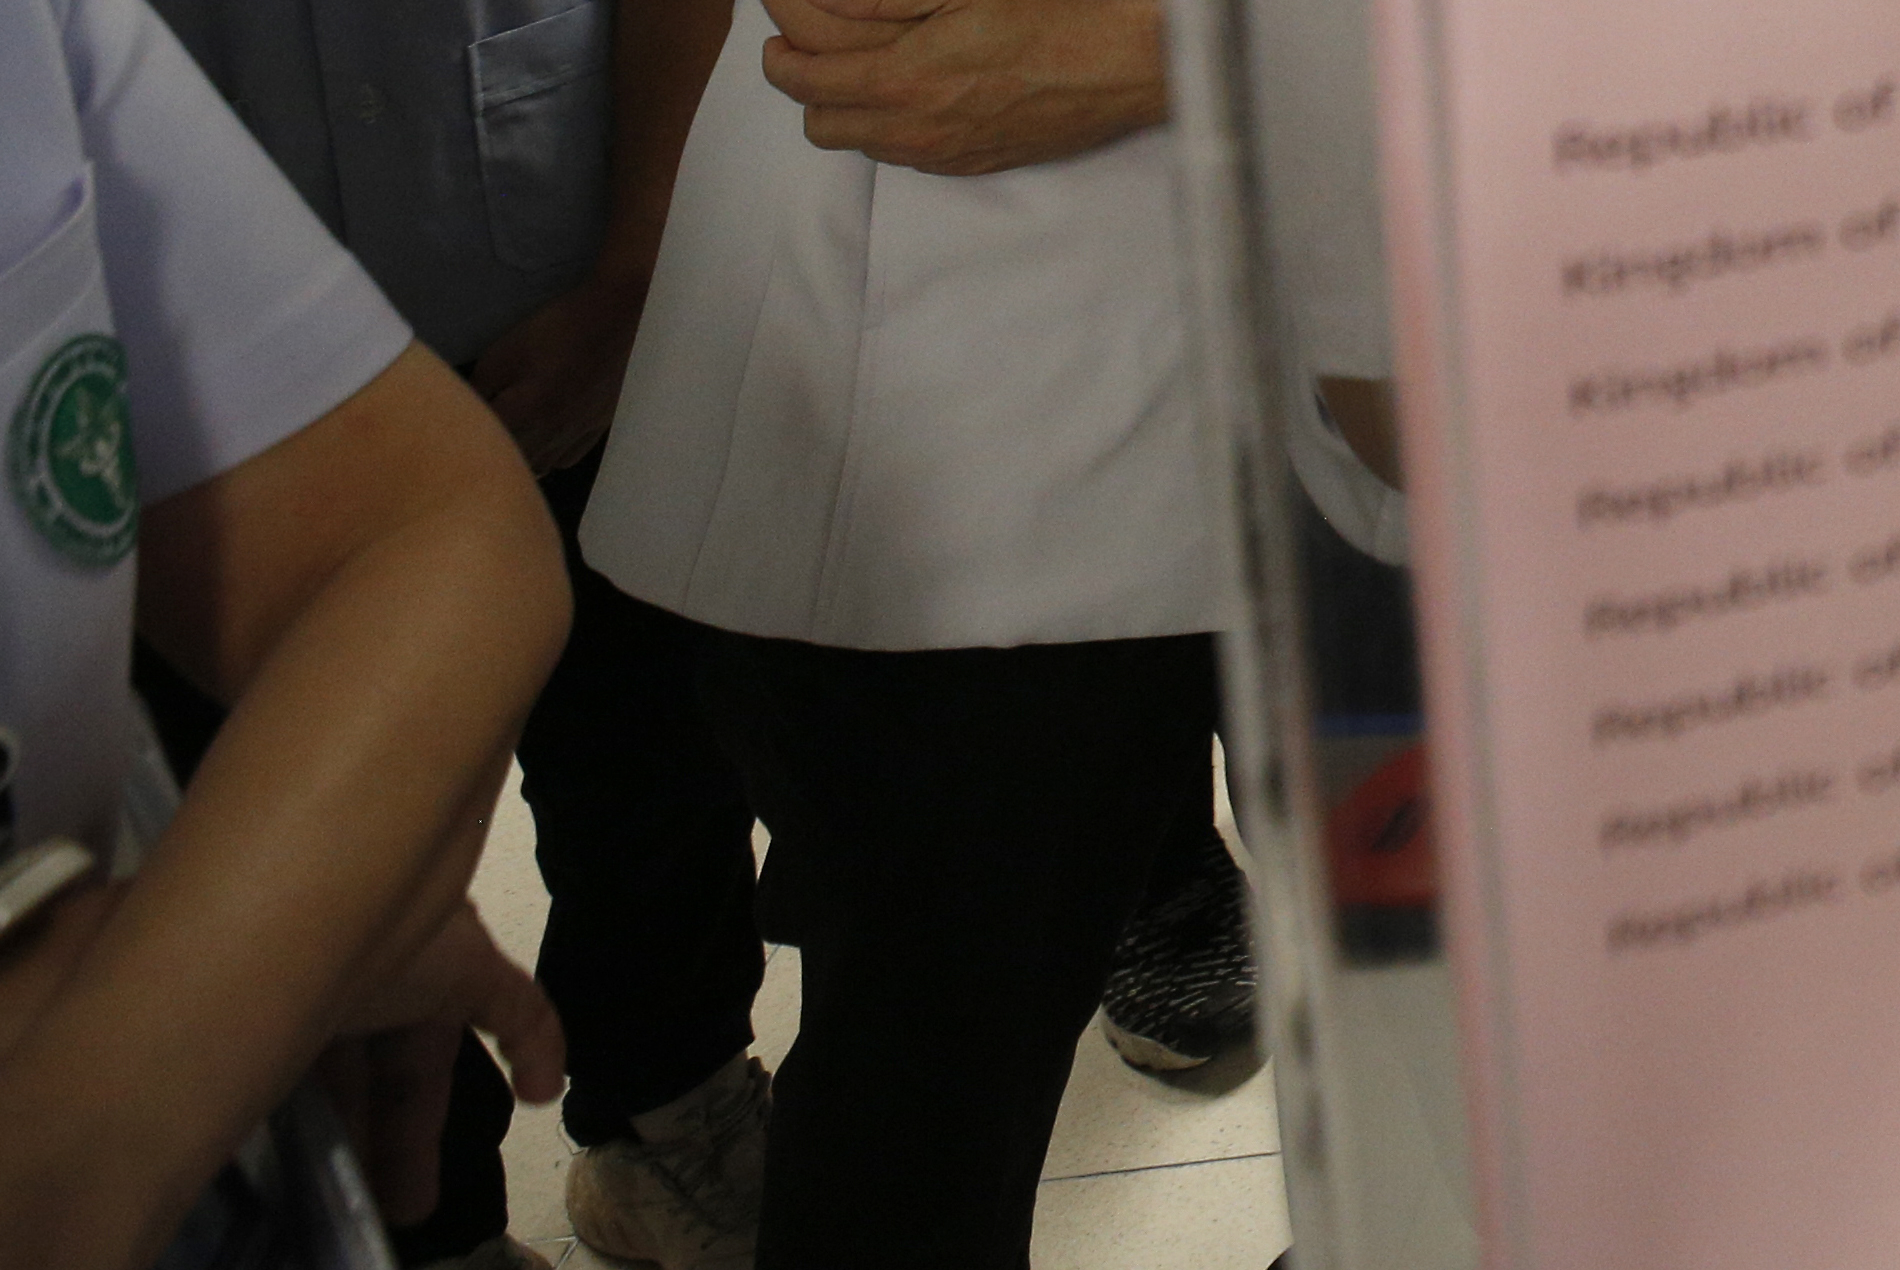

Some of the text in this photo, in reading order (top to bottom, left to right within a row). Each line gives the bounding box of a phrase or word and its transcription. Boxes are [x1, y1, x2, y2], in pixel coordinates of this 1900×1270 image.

[1550, 98, 1803, 173] Republic
[1832, 81, 1896, 132] of
[1560, 223, 1823, 298] Kingdom
[1840, 201, 1900, 252] of
[1567, 342, 1828, 418] Kingdom
[1577, 450, 1825, 532] Republic
[1585, 562, 1829, 643] Republic
[1592, 668, 1836, 748] Republic
[1600, 775, 1840, 858] Republic
[1605, 875, 1849, 955] Republic
